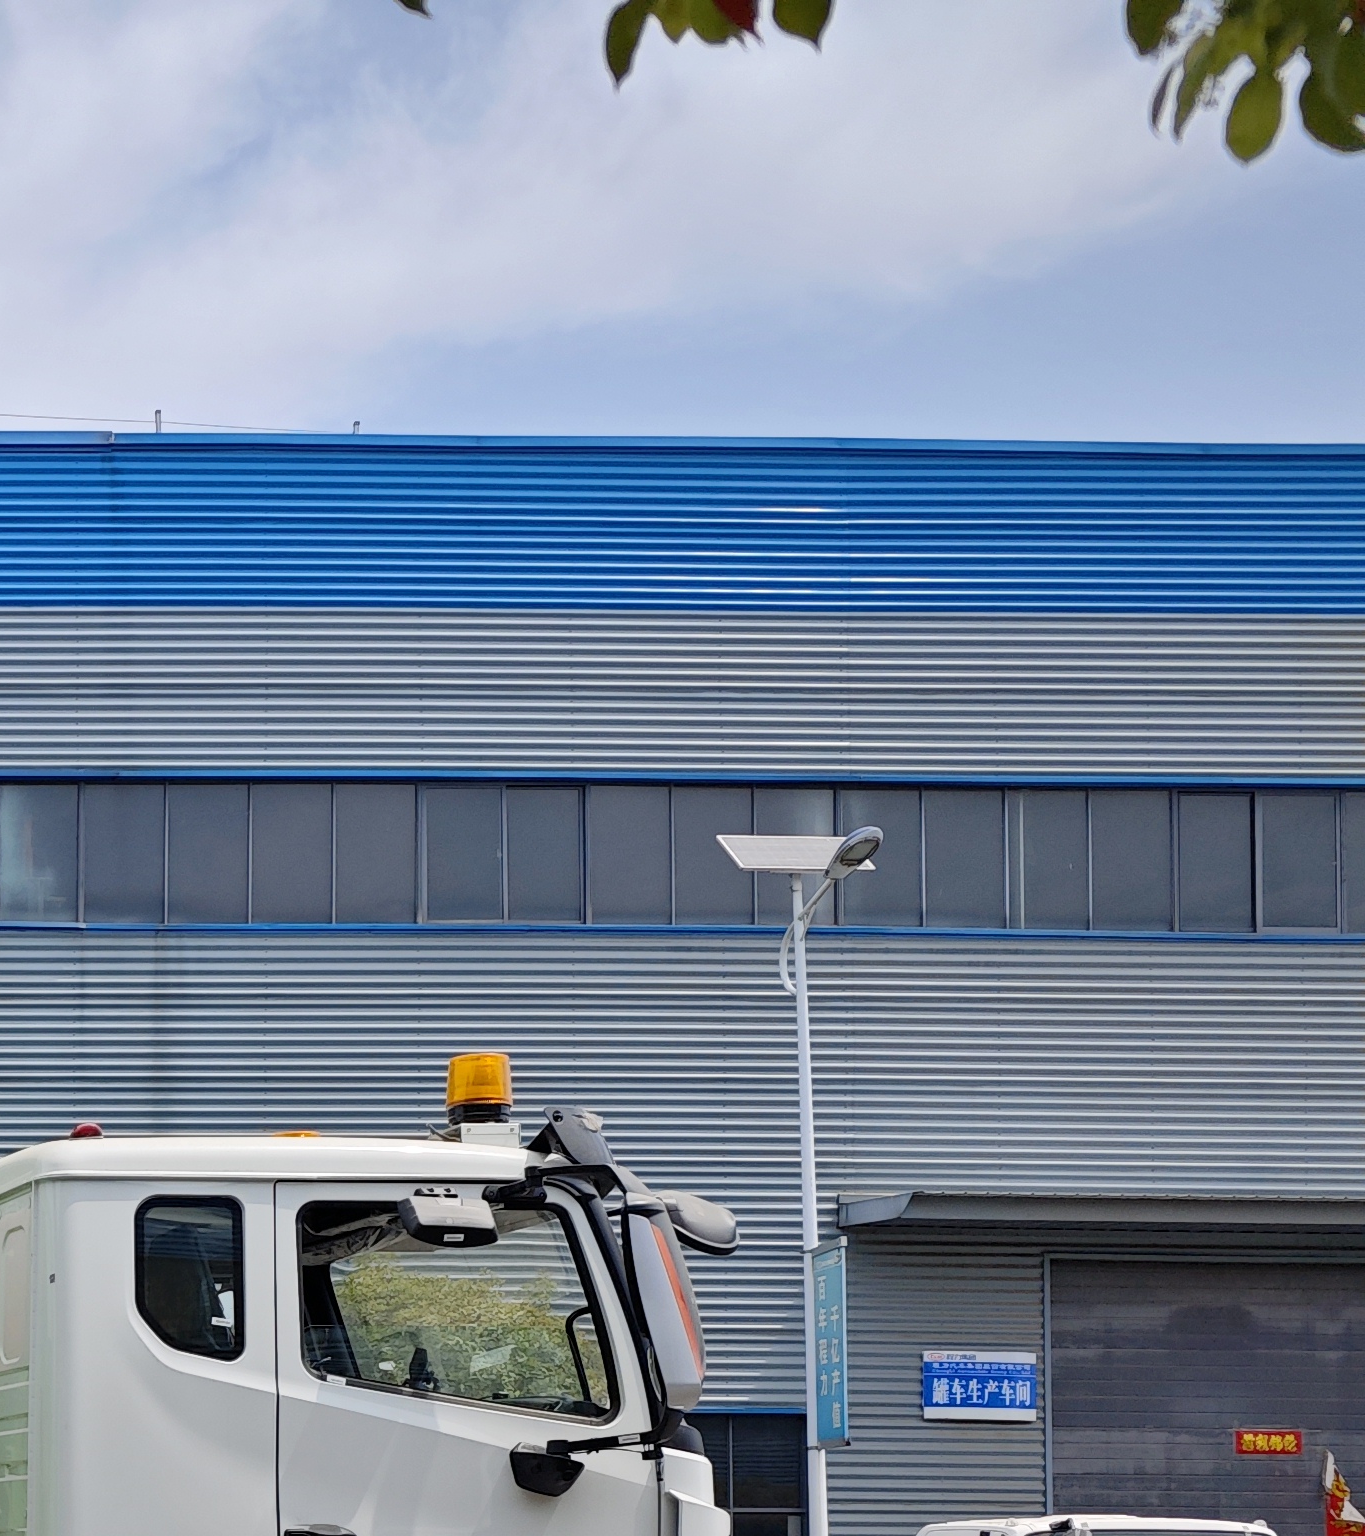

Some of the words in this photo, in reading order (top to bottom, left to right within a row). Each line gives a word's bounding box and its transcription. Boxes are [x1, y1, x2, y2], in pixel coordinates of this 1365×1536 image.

[817, 1275, 829, 1397] 百年程力
[830, 1304, 842, 1429] 千亿产值
[932, 1377, 1031, 1406] 罐车生产车间
